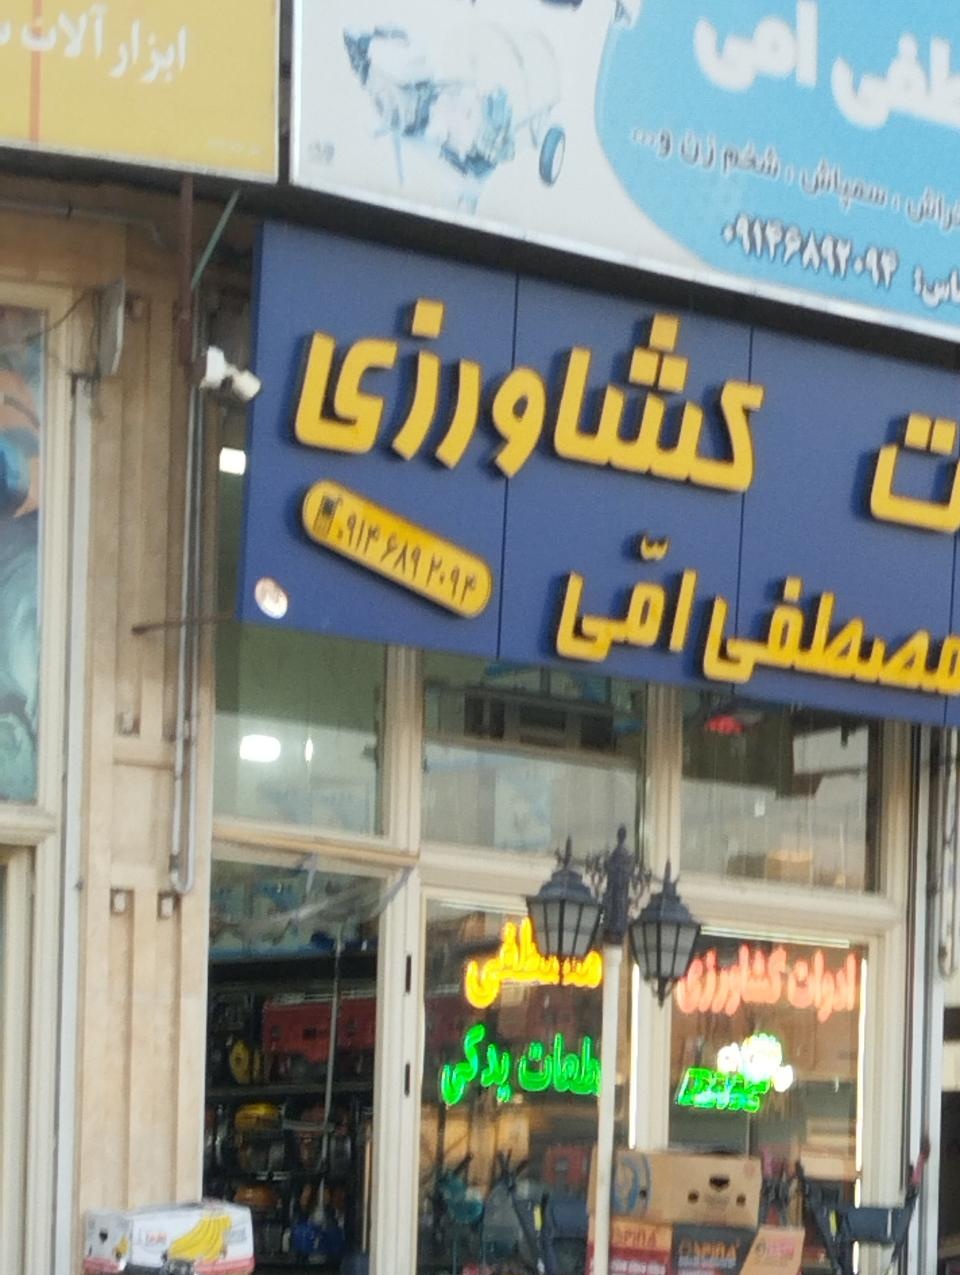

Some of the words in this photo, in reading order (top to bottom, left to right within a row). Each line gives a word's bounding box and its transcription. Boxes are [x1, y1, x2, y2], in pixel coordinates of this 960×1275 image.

[20, 1, 107, 58] آلات
[110, 18, 188, 84] ابزار
[295, 297, 765, 492] کشاورزی
[441, 1023, 512, 1106] یدکی
[518, 1032, 602, 1097] طعات
